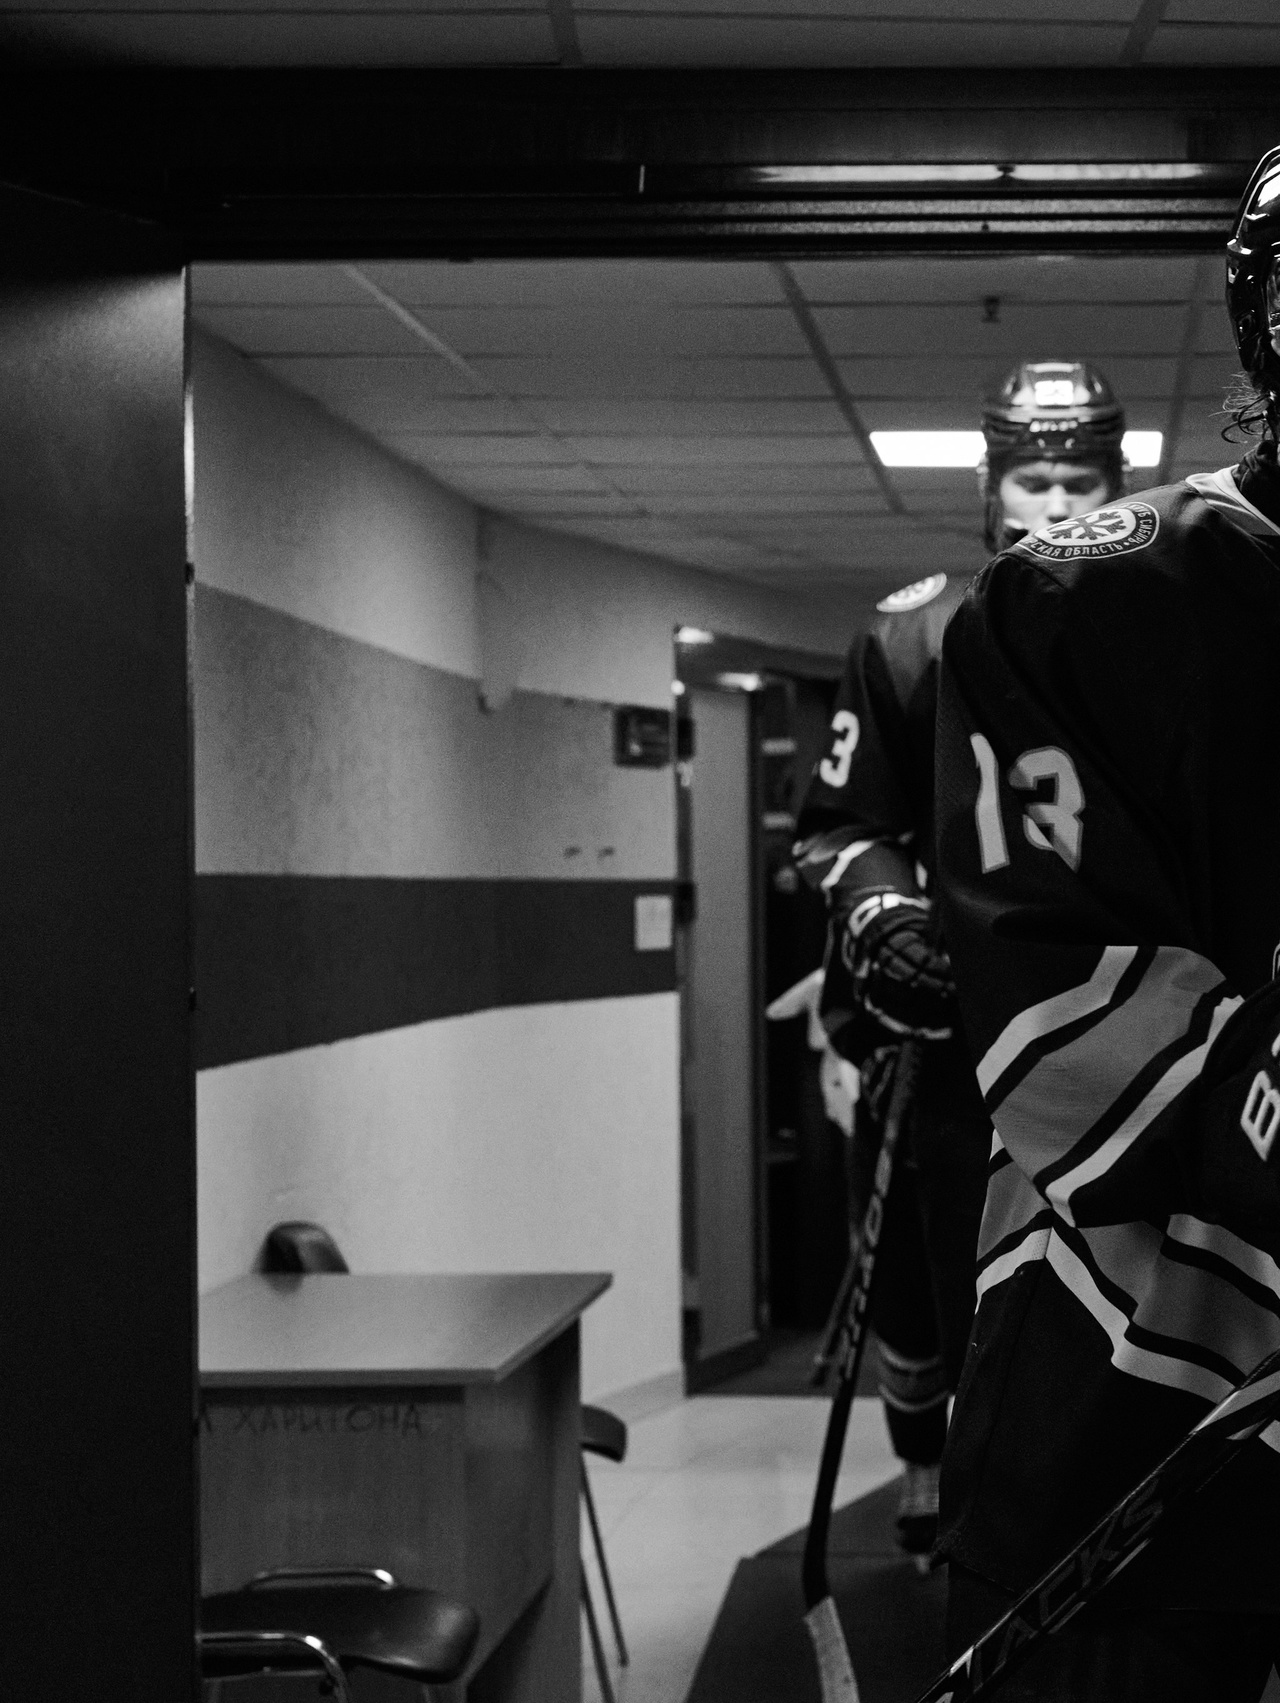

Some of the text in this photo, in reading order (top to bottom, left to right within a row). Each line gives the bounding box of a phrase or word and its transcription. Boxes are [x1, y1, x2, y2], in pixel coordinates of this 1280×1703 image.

[1064, 542, 1124, 557] ОБЛАСТЬ
[820, 709, 860, 789] 3
[969, 732, 1086, 874] 13
